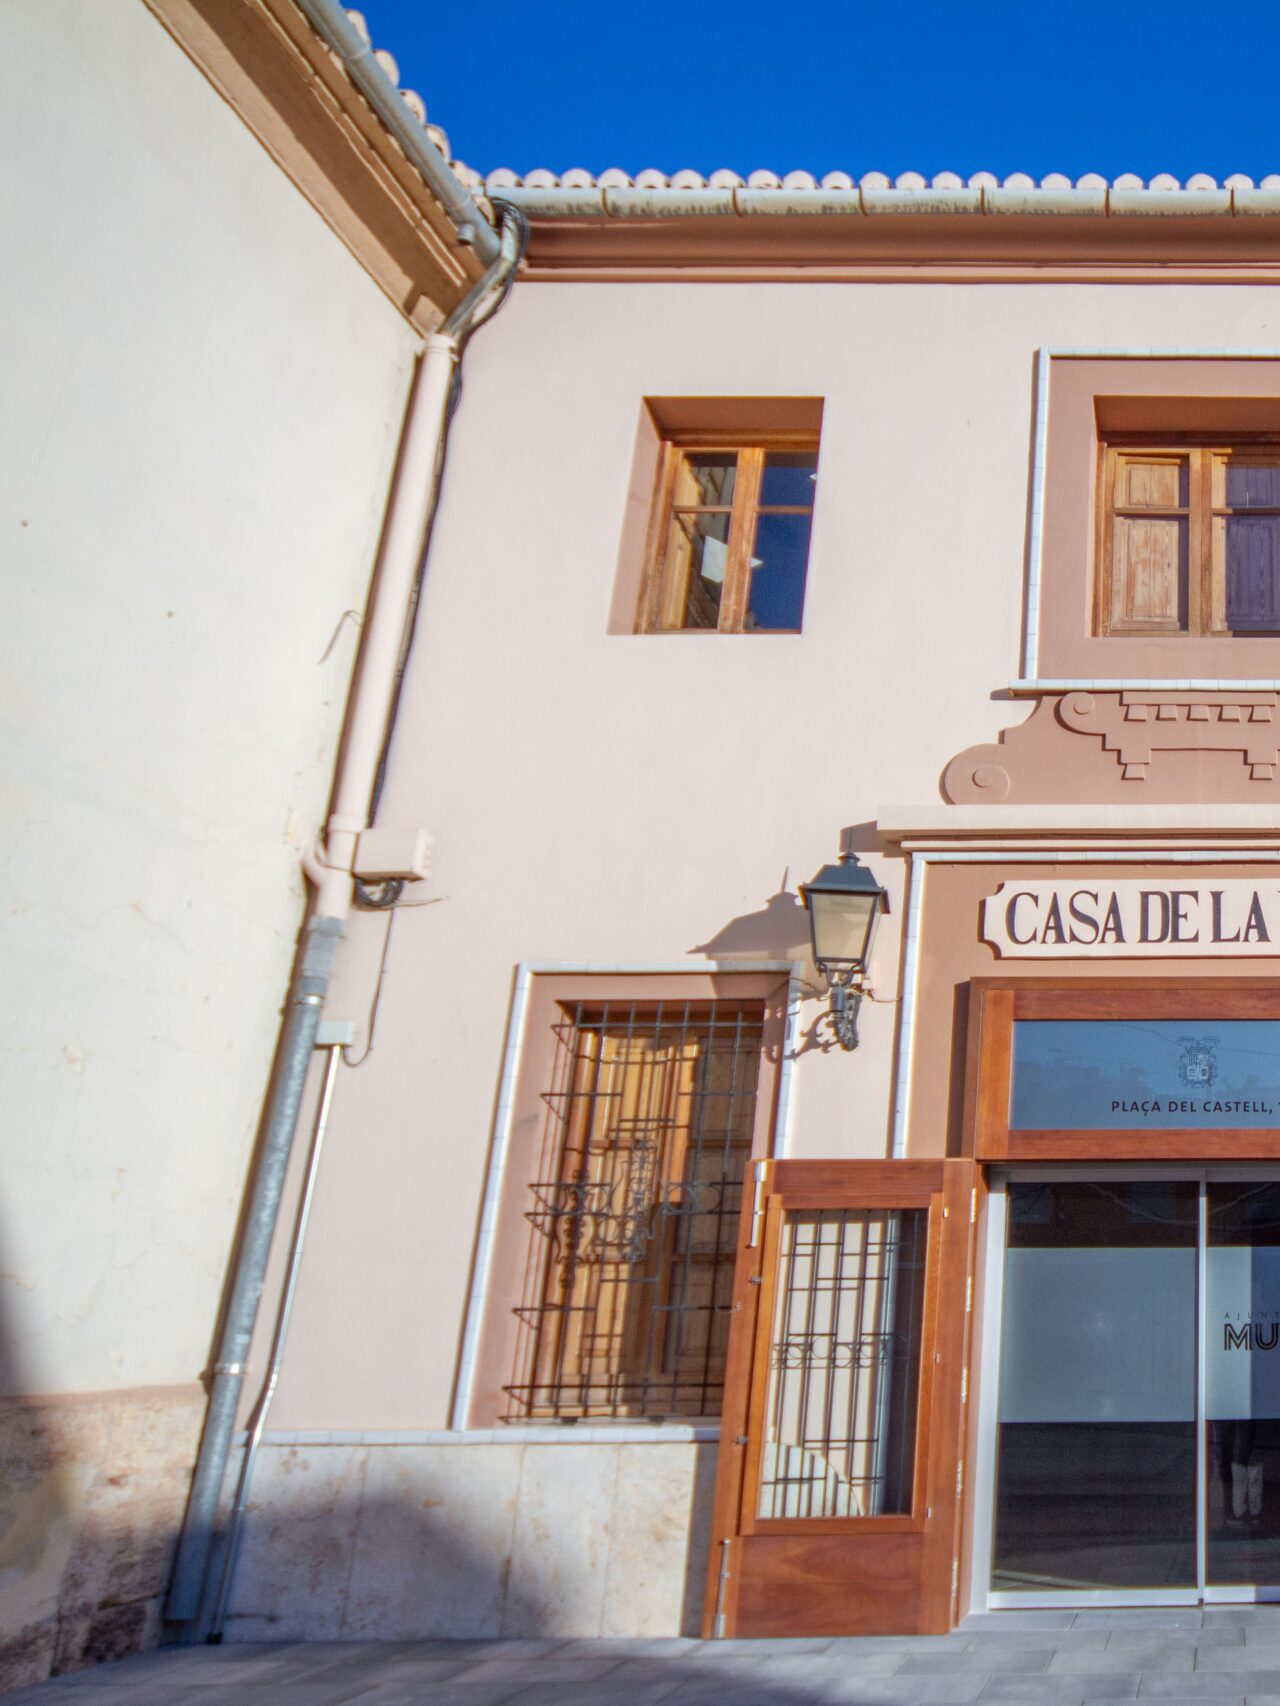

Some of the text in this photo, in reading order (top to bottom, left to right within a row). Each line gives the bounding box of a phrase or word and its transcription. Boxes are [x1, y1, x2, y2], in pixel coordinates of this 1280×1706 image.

[1005, 890, 1126, 945] CASA
[1138, 890, 1200, 944] DE
[1209, 890, 1271, 944] LA
[1111, 1101, 1161, 1117] PLAÇA
[1168, 1101, 1197, 1113] DEL
[1202, 1101, 1273, 1115] CASTELL,
